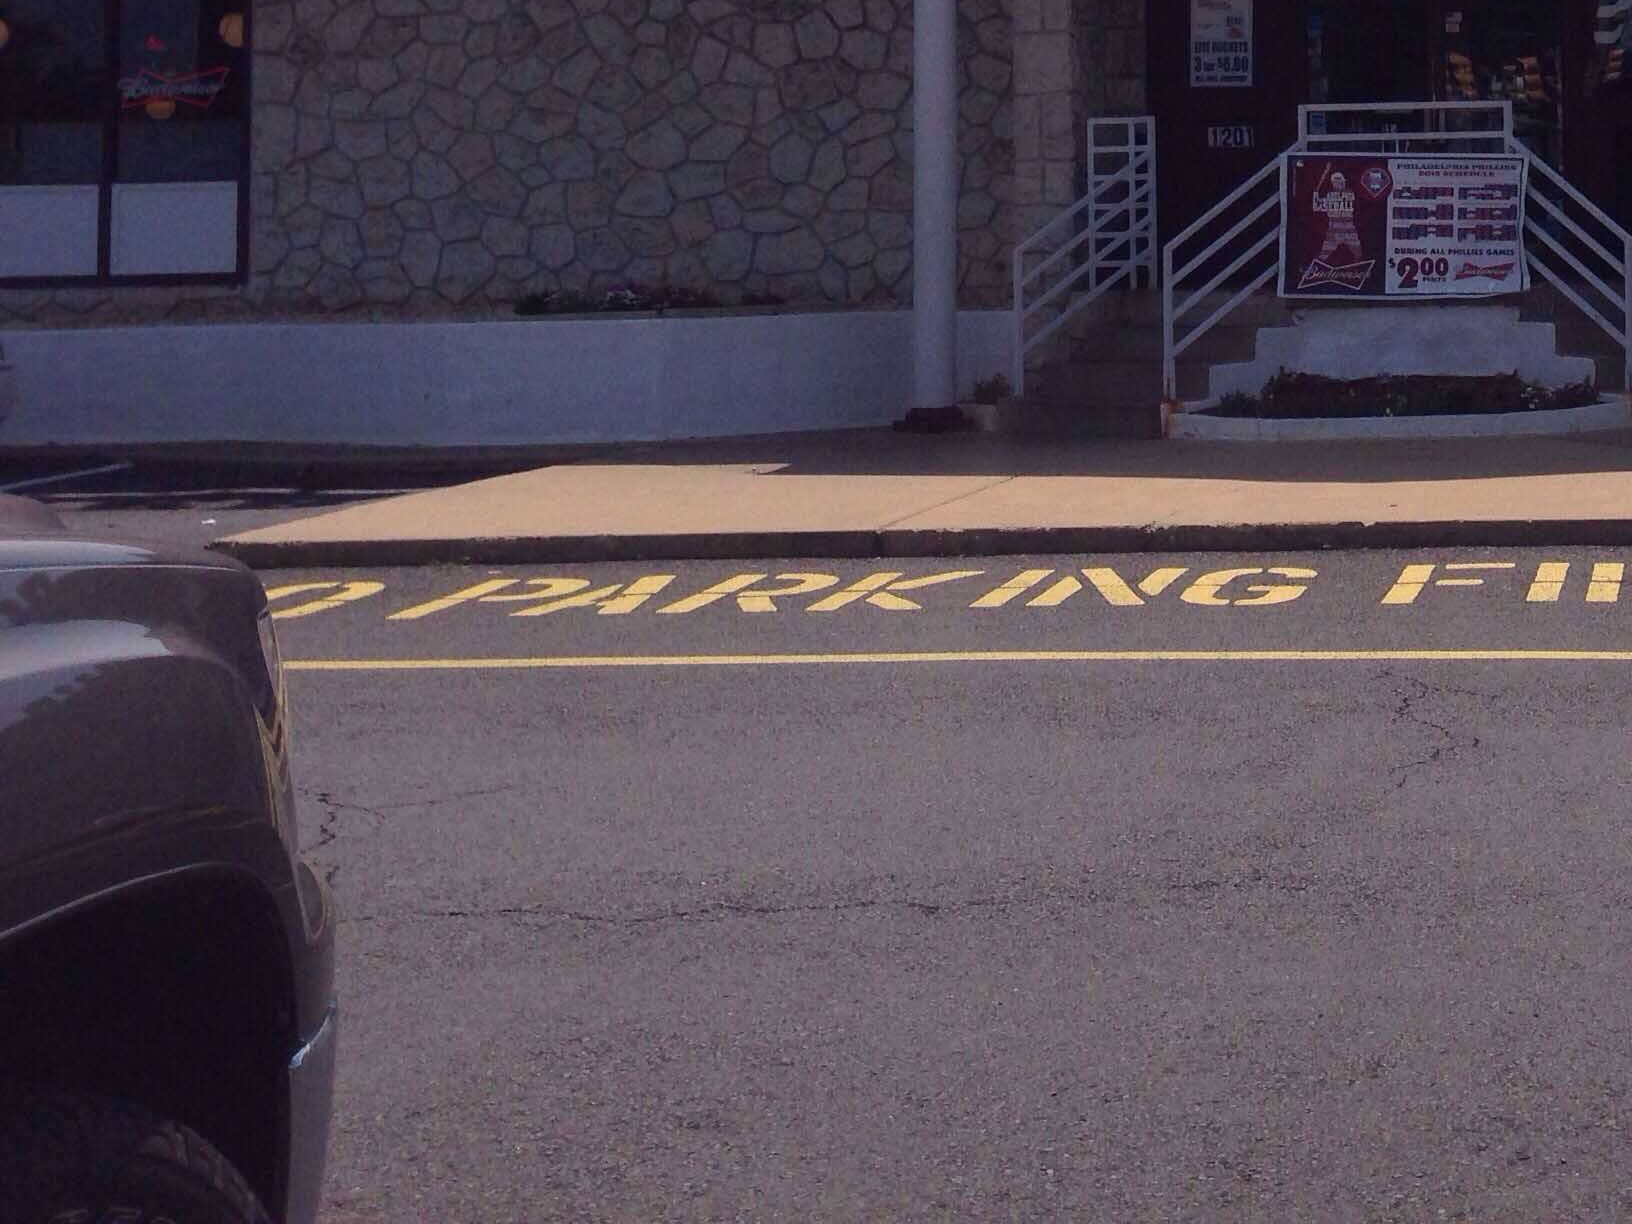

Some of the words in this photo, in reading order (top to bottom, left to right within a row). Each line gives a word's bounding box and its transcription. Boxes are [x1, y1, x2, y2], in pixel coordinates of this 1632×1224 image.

[1209, 127, 1254, 147] 1201
[1394, 247, 1428, 255] DURING
[1430, 247, 1446, 255] ALL
[1448, 247, 1483, 255] PHILLIES
[1486, 247, 1514, 255] GAMES
[385, 566, 1319, 620] PARKING
